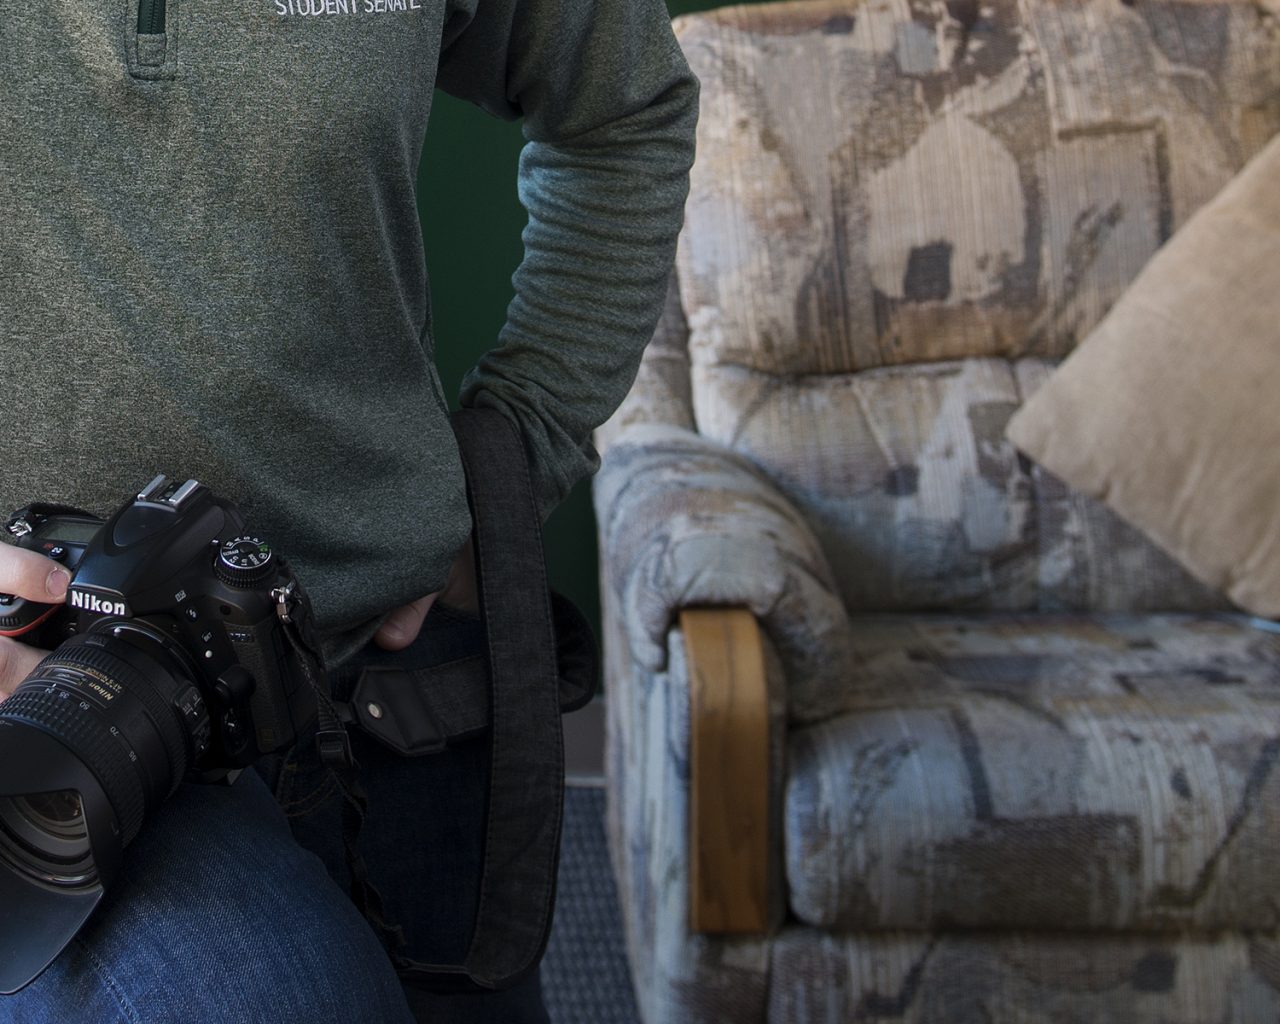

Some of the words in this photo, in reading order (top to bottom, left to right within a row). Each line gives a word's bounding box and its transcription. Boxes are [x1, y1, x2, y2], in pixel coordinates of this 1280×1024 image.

[71, 590, 125, 616] Nikon
[88, 681, 114, 701] Nikon
[79, 701, 90, 711] 50
[109, 726, 120, 737] 70
